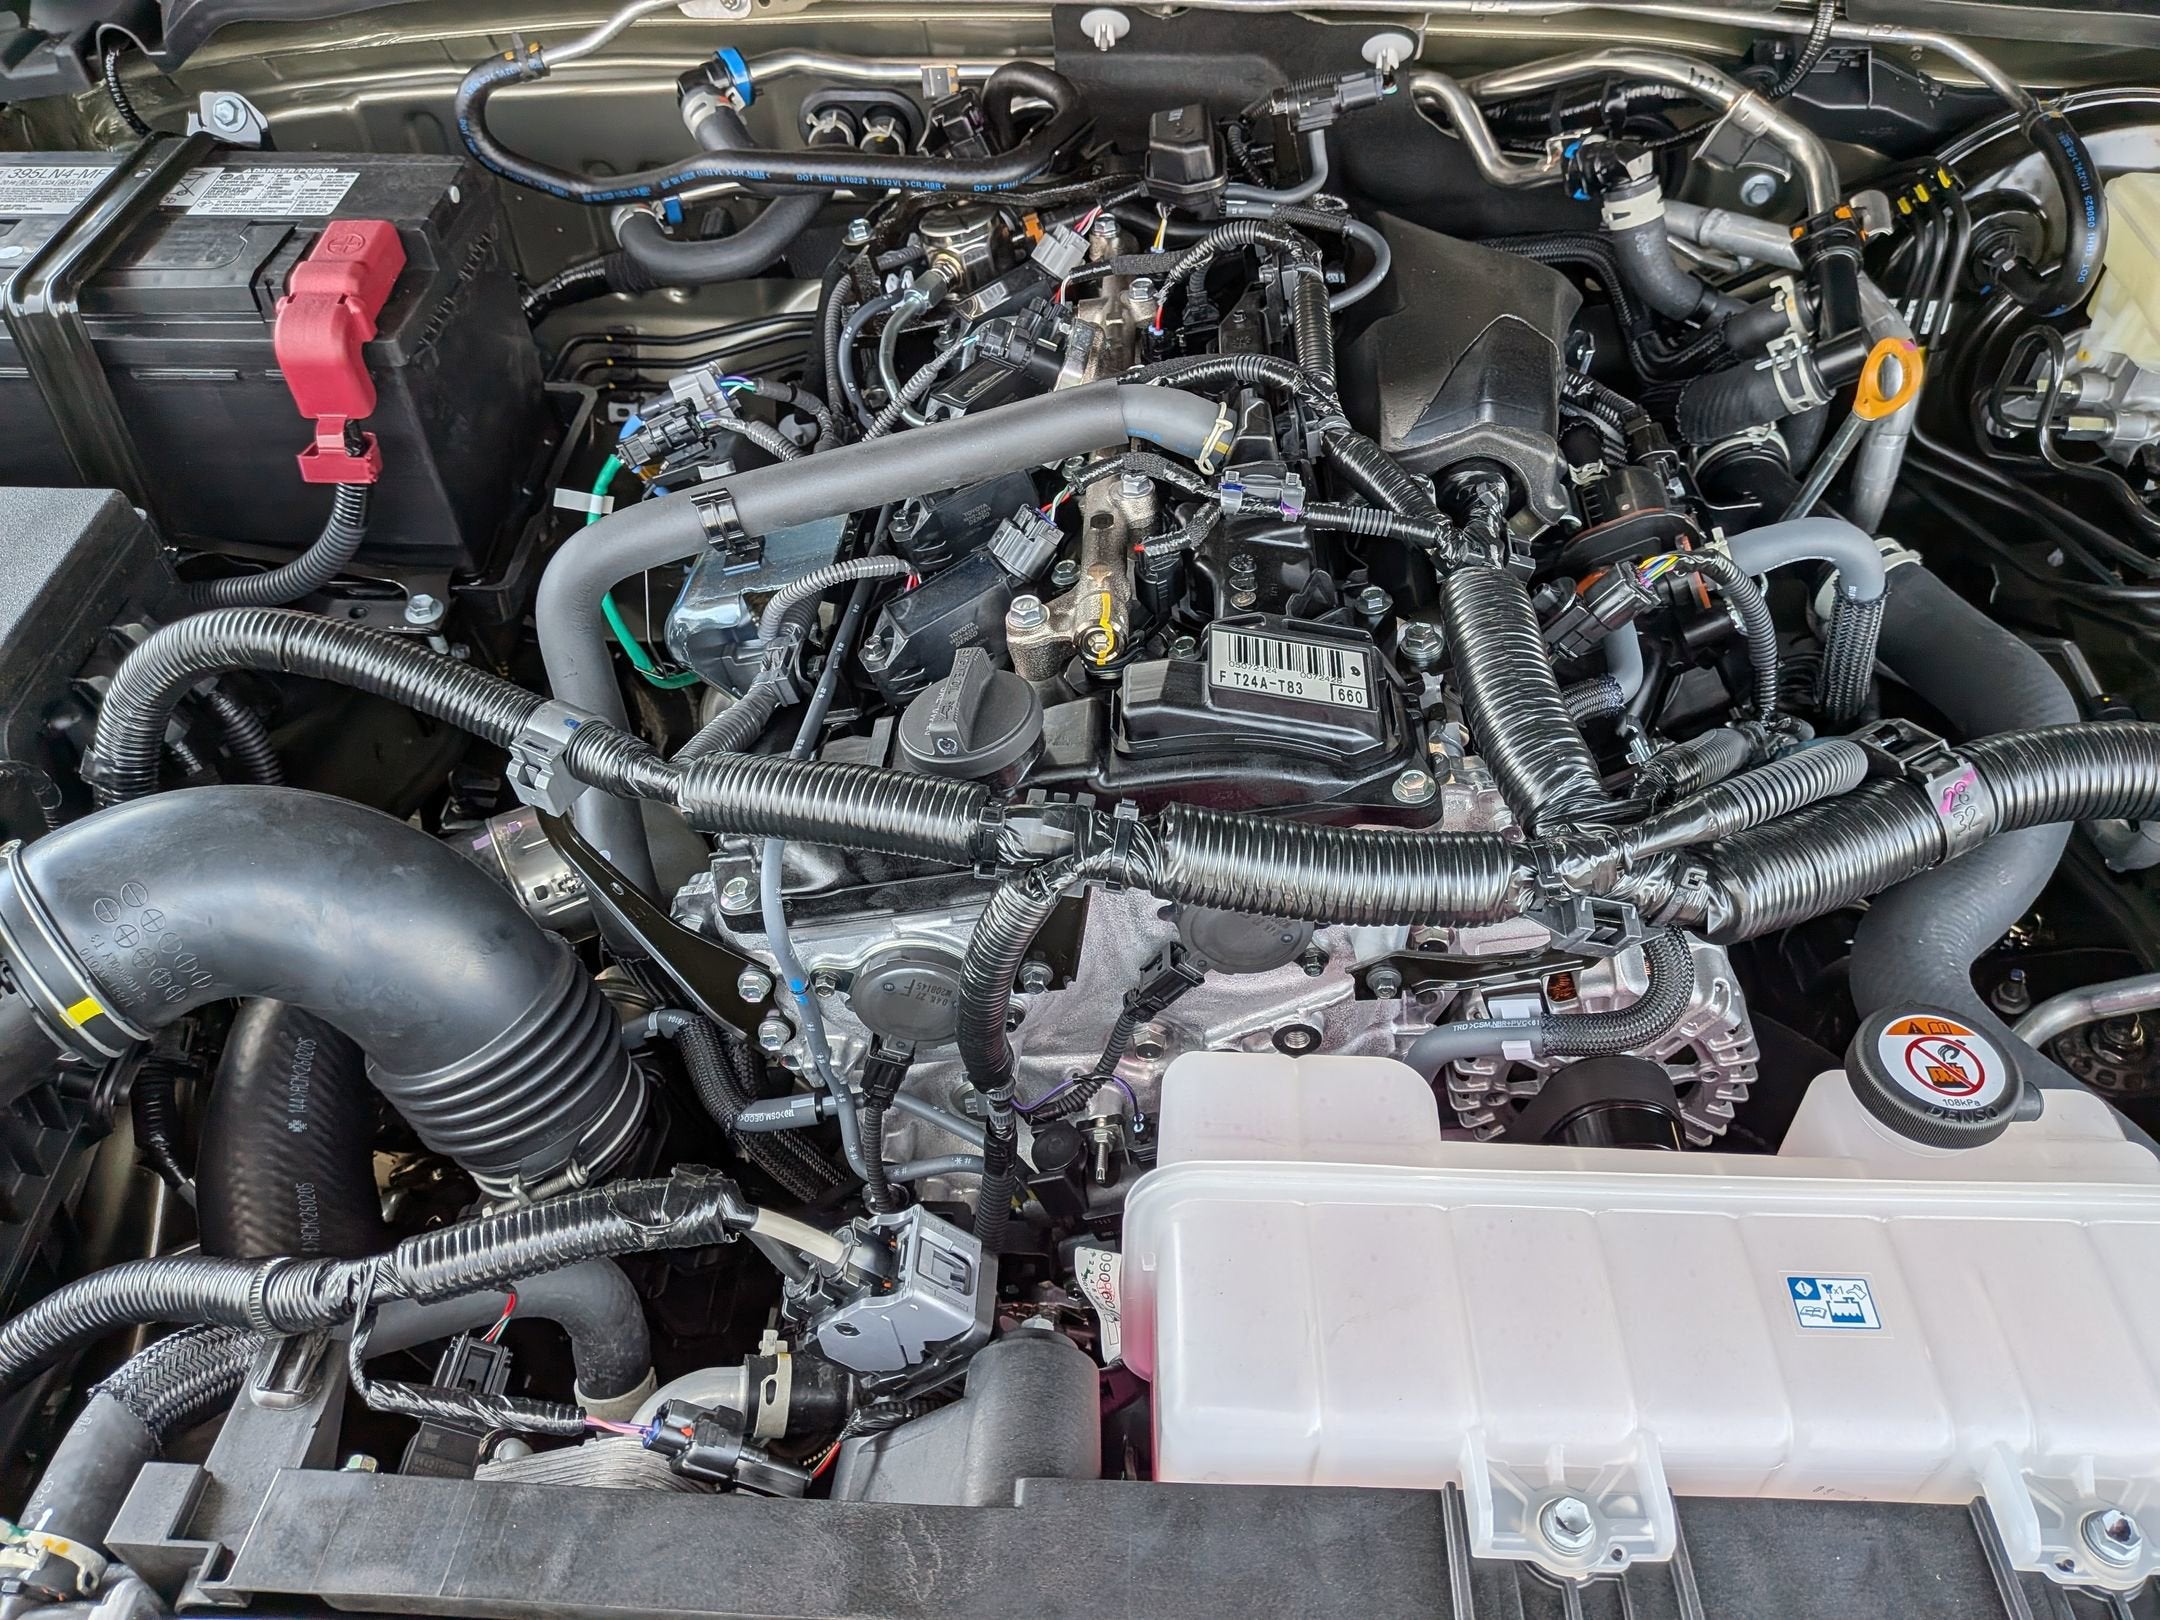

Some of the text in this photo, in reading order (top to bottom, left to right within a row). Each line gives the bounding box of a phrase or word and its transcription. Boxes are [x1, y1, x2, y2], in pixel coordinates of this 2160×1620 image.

[8, 168, 109, 179] 395LN4-MF
[796, 173, 814, 182] DOT
[973, 183, 993, 192] DOT
[2077, 263, 2091, 283] DOT
[949, 621, 975, 639] TOYOTA
[1219, 670, 1304, 695] F T24A-T83
[1338, 688, 1363, 704] 660
[1942, 1098, 1981, 1107] 108kPa
[1925, 1105, 2000, 1124] DENSO
